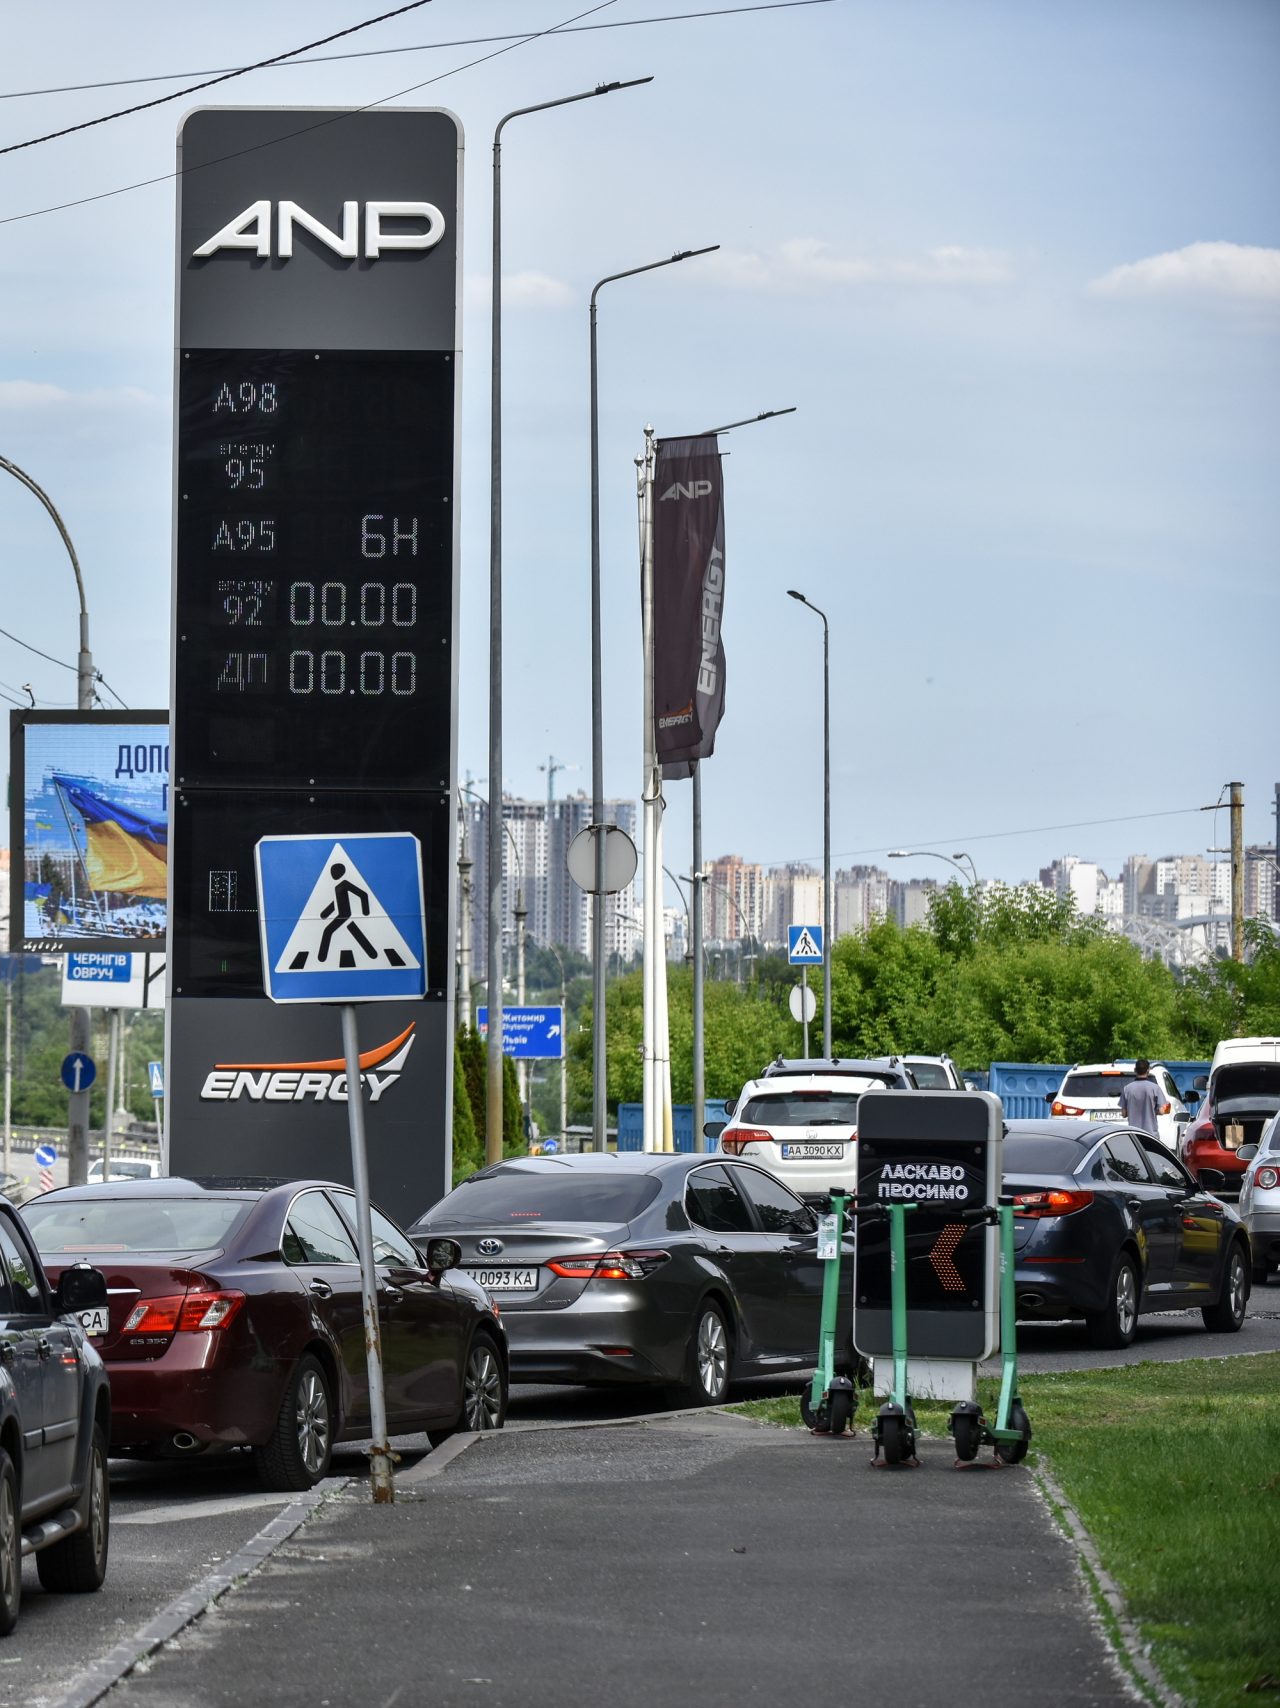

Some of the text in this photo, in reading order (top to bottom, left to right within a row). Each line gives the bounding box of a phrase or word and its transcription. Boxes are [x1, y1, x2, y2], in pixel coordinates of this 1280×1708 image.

[192, 200, 446, 258] ANP
[225, 459, 264, 489] 95
[659, 480, 713, 501] ANP
[223, 582, 417, 627] 92 00.00
[217, 650, 417, 695] ДП 00.00
[72, 966, 114, 980] ОВРУЧ
[200, 1071, 401, 1101] ENERGY
[803, 1146, 826, 1155] 3090
[880, 1164, 965, 1180] ЛАСКАВО
[877, 1182, 969, 1200] ПРОСИМО
[480, 1271, 511, 1286] 0093
[513, 1271, 533, 1285] KA
